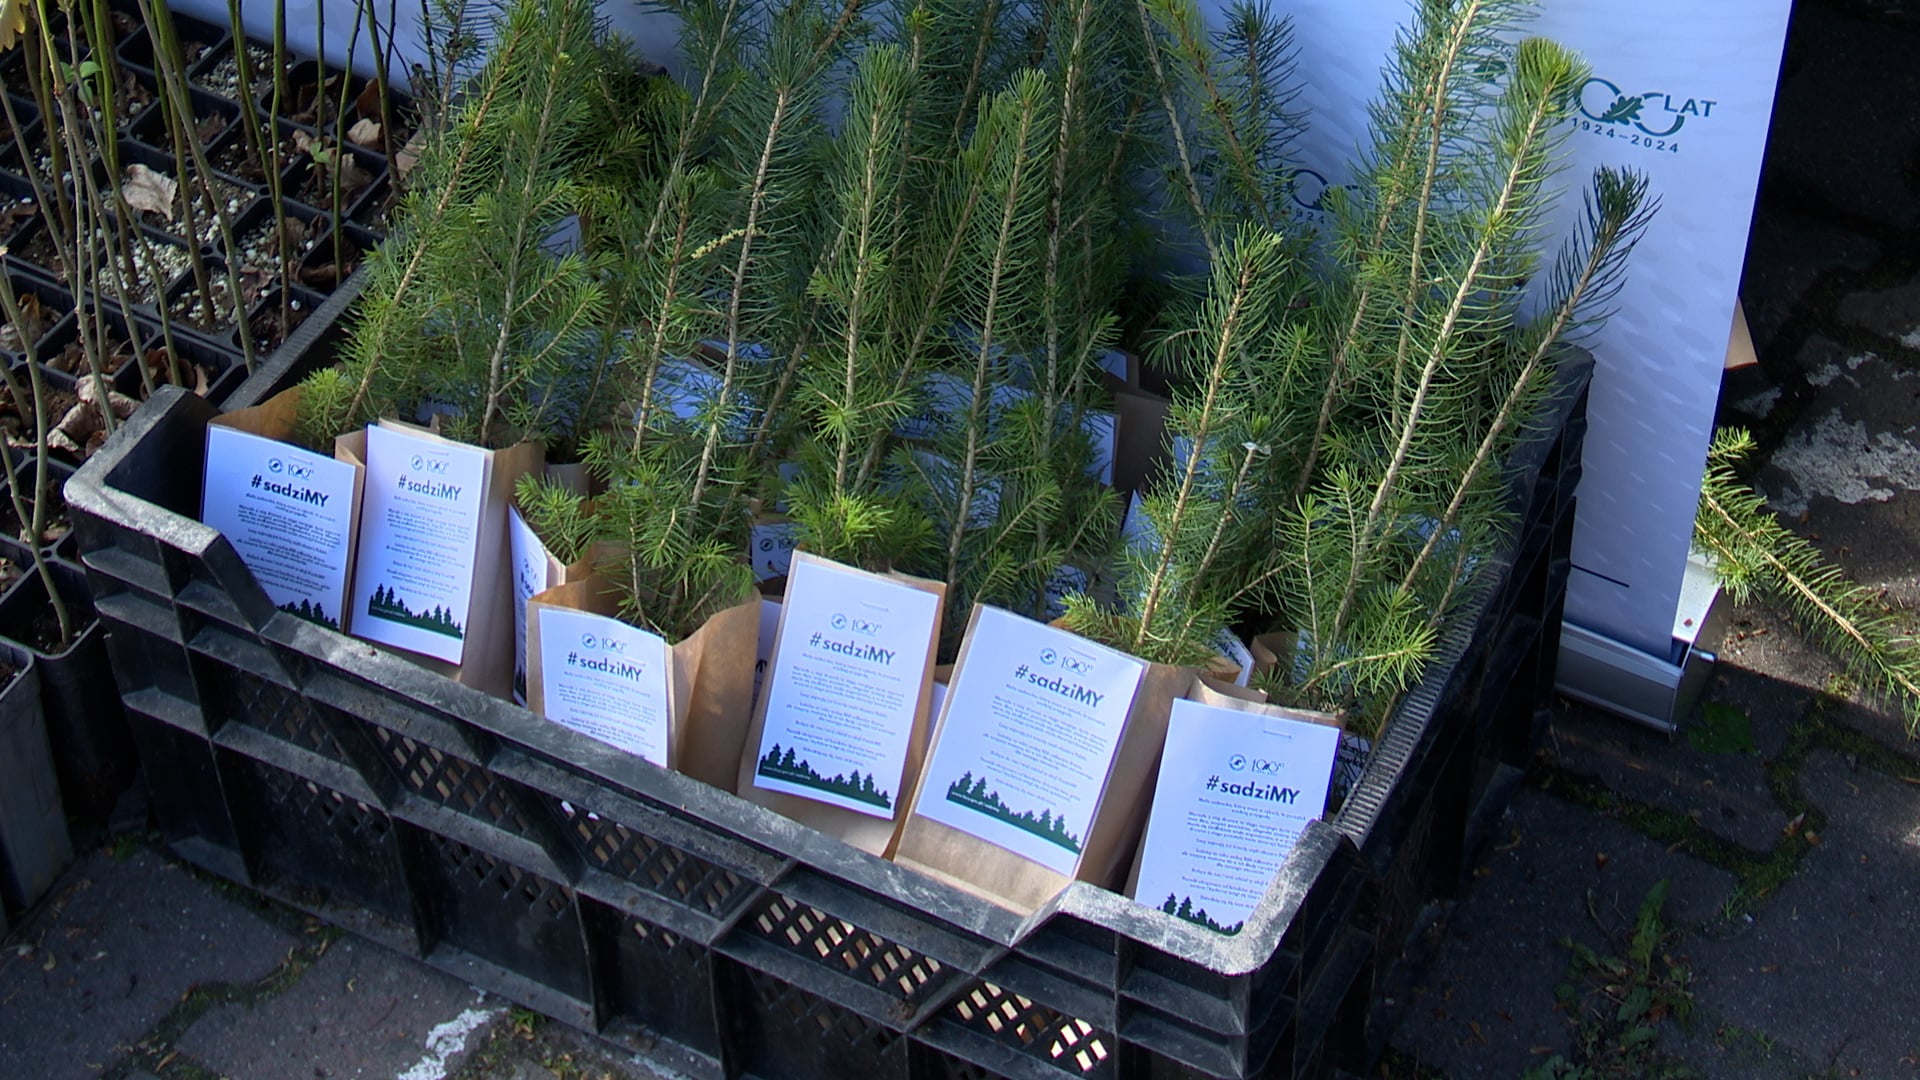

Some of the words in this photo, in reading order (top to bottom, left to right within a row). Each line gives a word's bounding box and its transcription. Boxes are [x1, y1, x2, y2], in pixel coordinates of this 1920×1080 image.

[1574, 77, 1685, 137] 00
[1663, 94, 1717, 118] LAT
[251, 474, 329, 507] #sadziMY
[398, 474, 462, 502] #sadziMY
[809, 631, 896, 666] #sadziMY
[567, 651, 643, 682] #sadziMY
[1014, 664, 1105, 709] #sadziMY
[1206, 774, 1301, 805] #sadziMY
